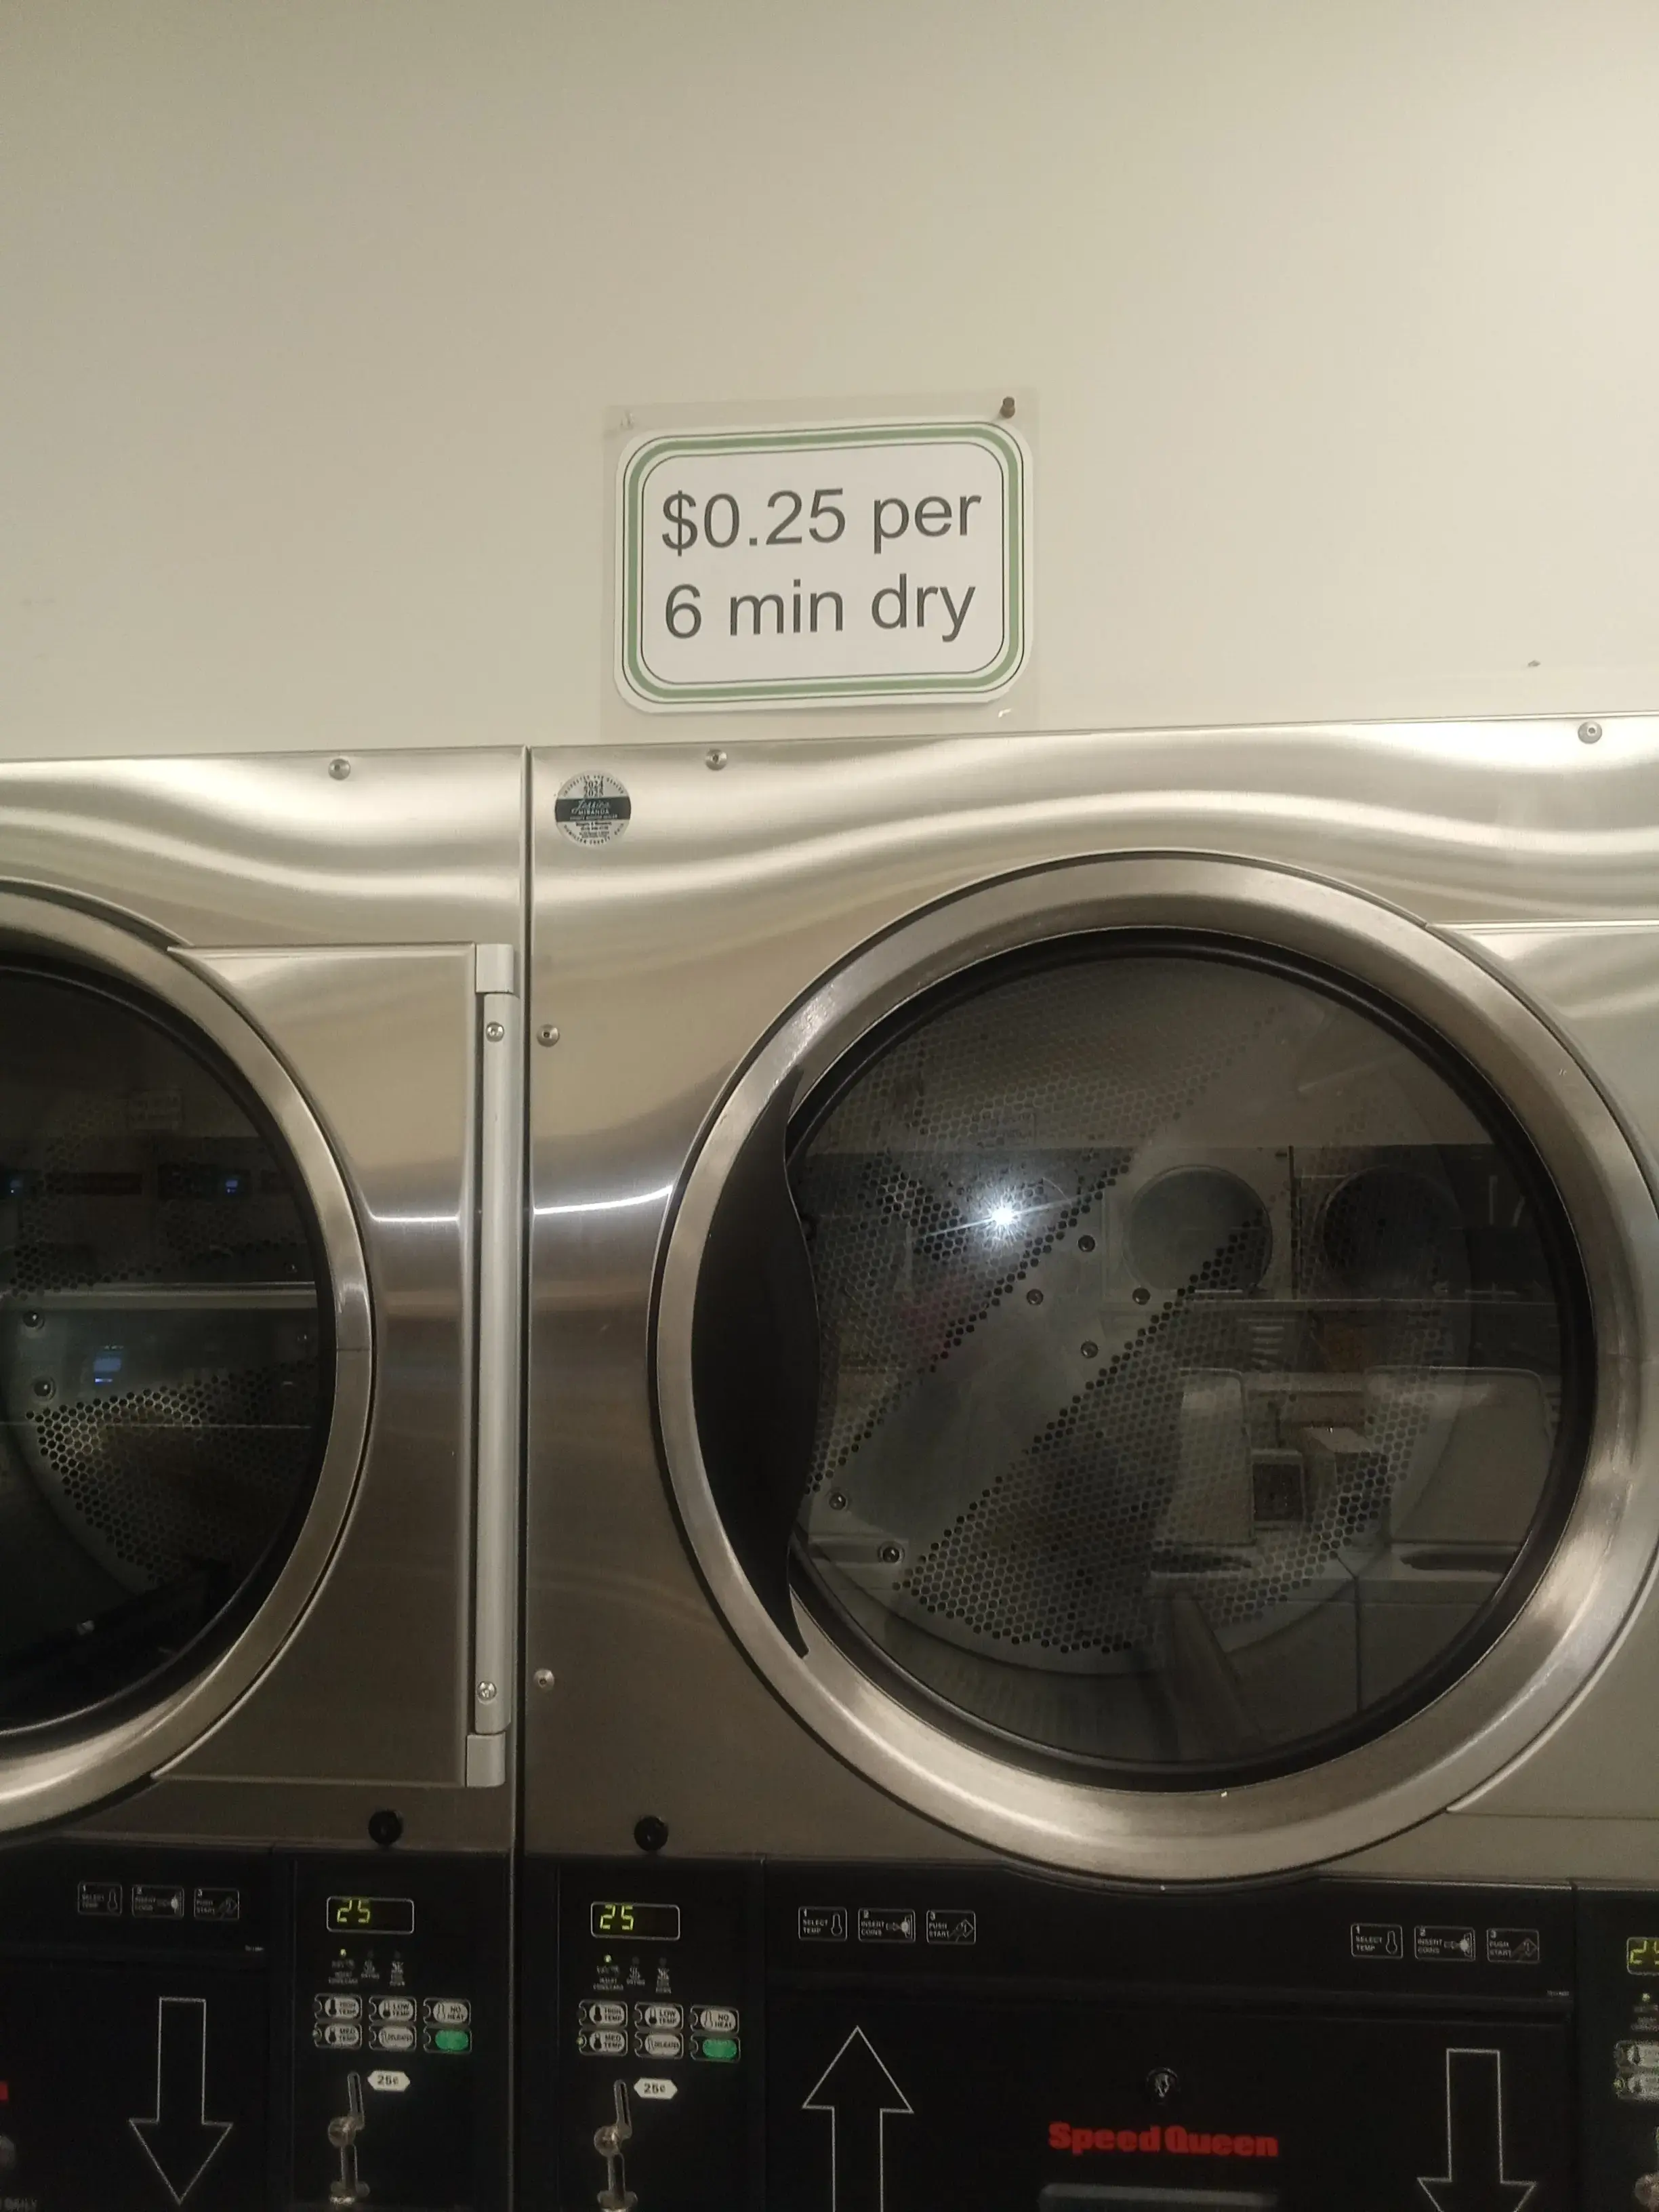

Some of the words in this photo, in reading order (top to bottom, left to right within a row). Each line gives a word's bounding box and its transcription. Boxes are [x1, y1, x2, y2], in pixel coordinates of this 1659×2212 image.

[661, 487, 846, 557] $0.25
[874, 493, 982, 554] per
[665, 583, 702, 638] 6
[730, 579, 843, 636] min
[871, 573, 976, 642] dry
[337, 1898, 371, 1924] 25
[600, 1904, 634, 1931] 25
[1048, 2121, 1161, 2155] Speed
[1164, 2125, 1279, 2157] Queen
